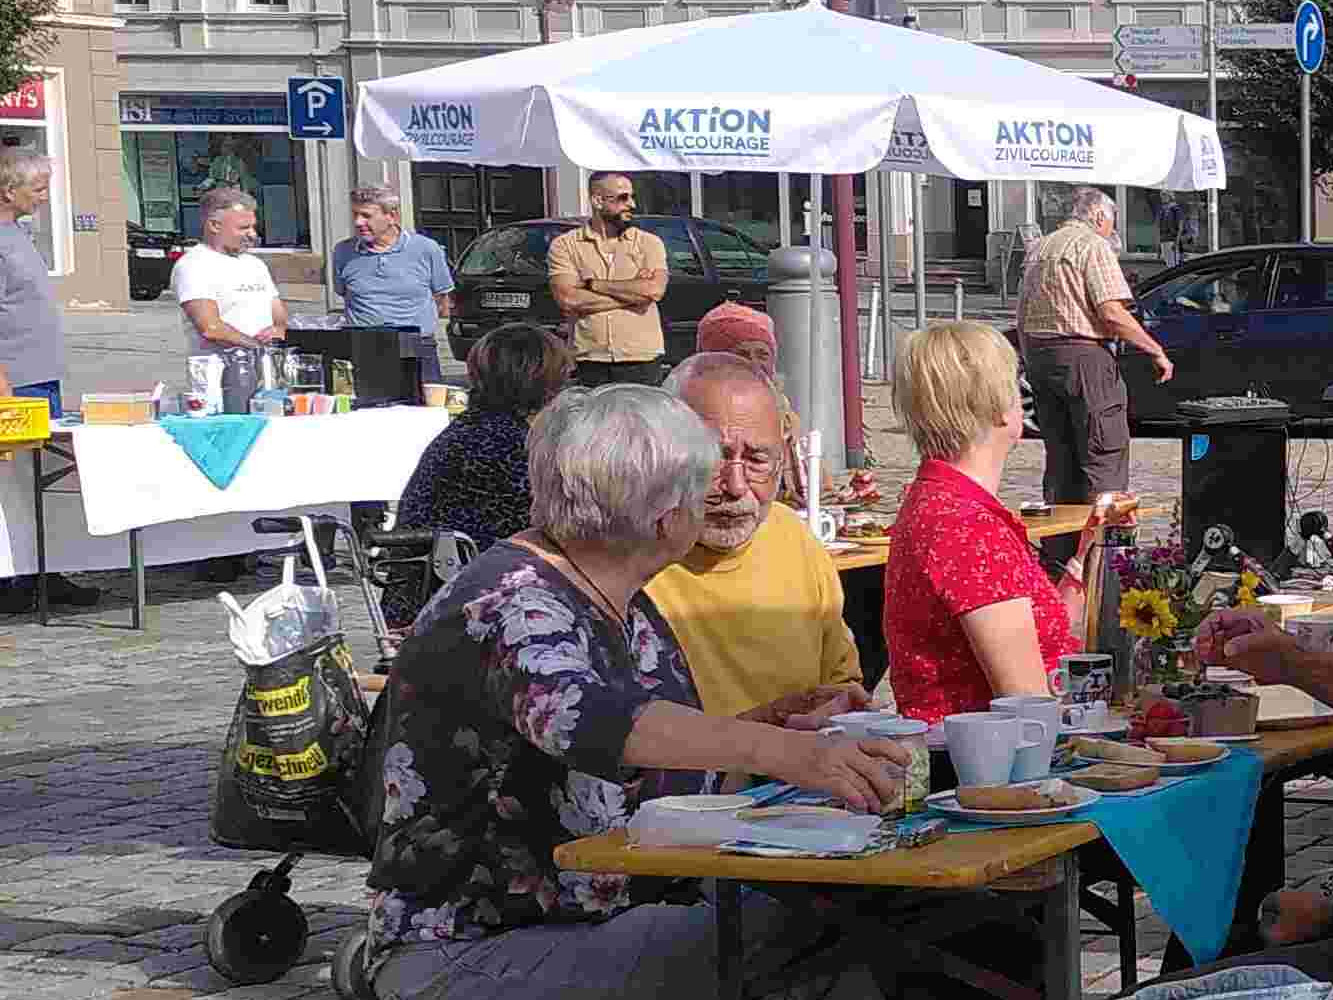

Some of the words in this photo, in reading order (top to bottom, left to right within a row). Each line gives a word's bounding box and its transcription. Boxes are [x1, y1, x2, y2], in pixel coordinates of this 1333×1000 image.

[307, 91, 326, 118] P
[639, 135, 771, 150] ZIVILCOURAGE
[994, 147, 1095, 164] ZIVILCOURAGE
